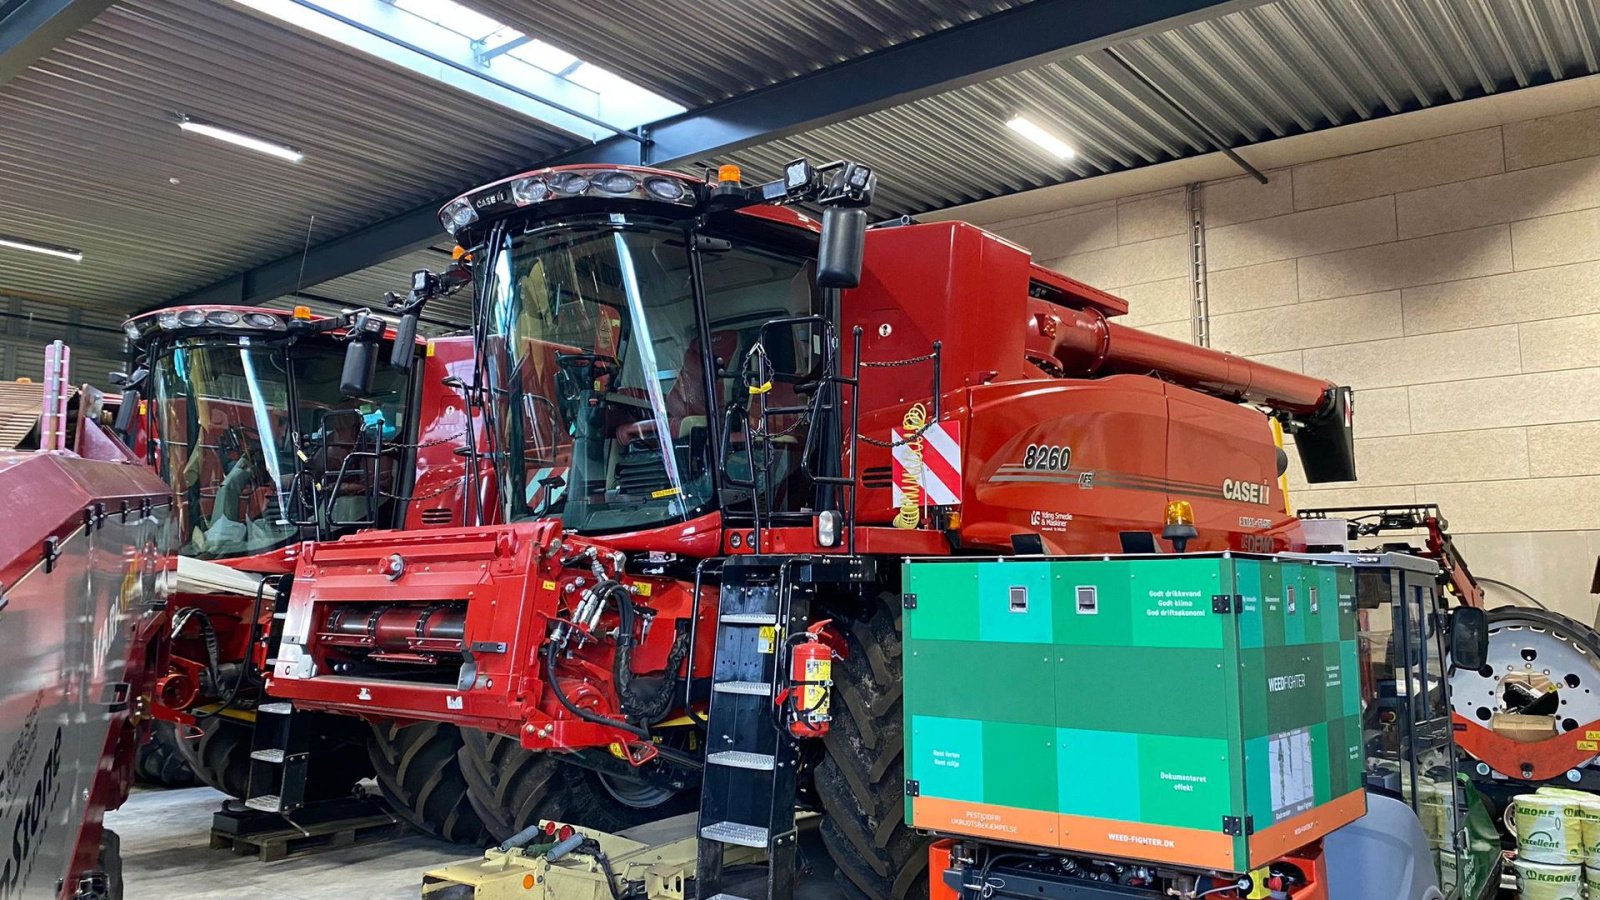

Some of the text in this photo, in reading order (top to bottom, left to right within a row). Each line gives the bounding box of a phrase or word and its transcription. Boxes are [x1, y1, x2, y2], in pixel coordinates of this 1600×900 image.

[476, 195, 497, 209] CASE
[1024, 444, 1071, 471] 8260
[1222, 478, 1259, 503] CASE
[1160, 772, 1206, 783] Dokumenteret
[1108, 832, 1176, 848] WEED-FIGHTER.DK
[1521, 837, 1560, 849] excellent
[1538, 873, 1577, 883] KRONE
